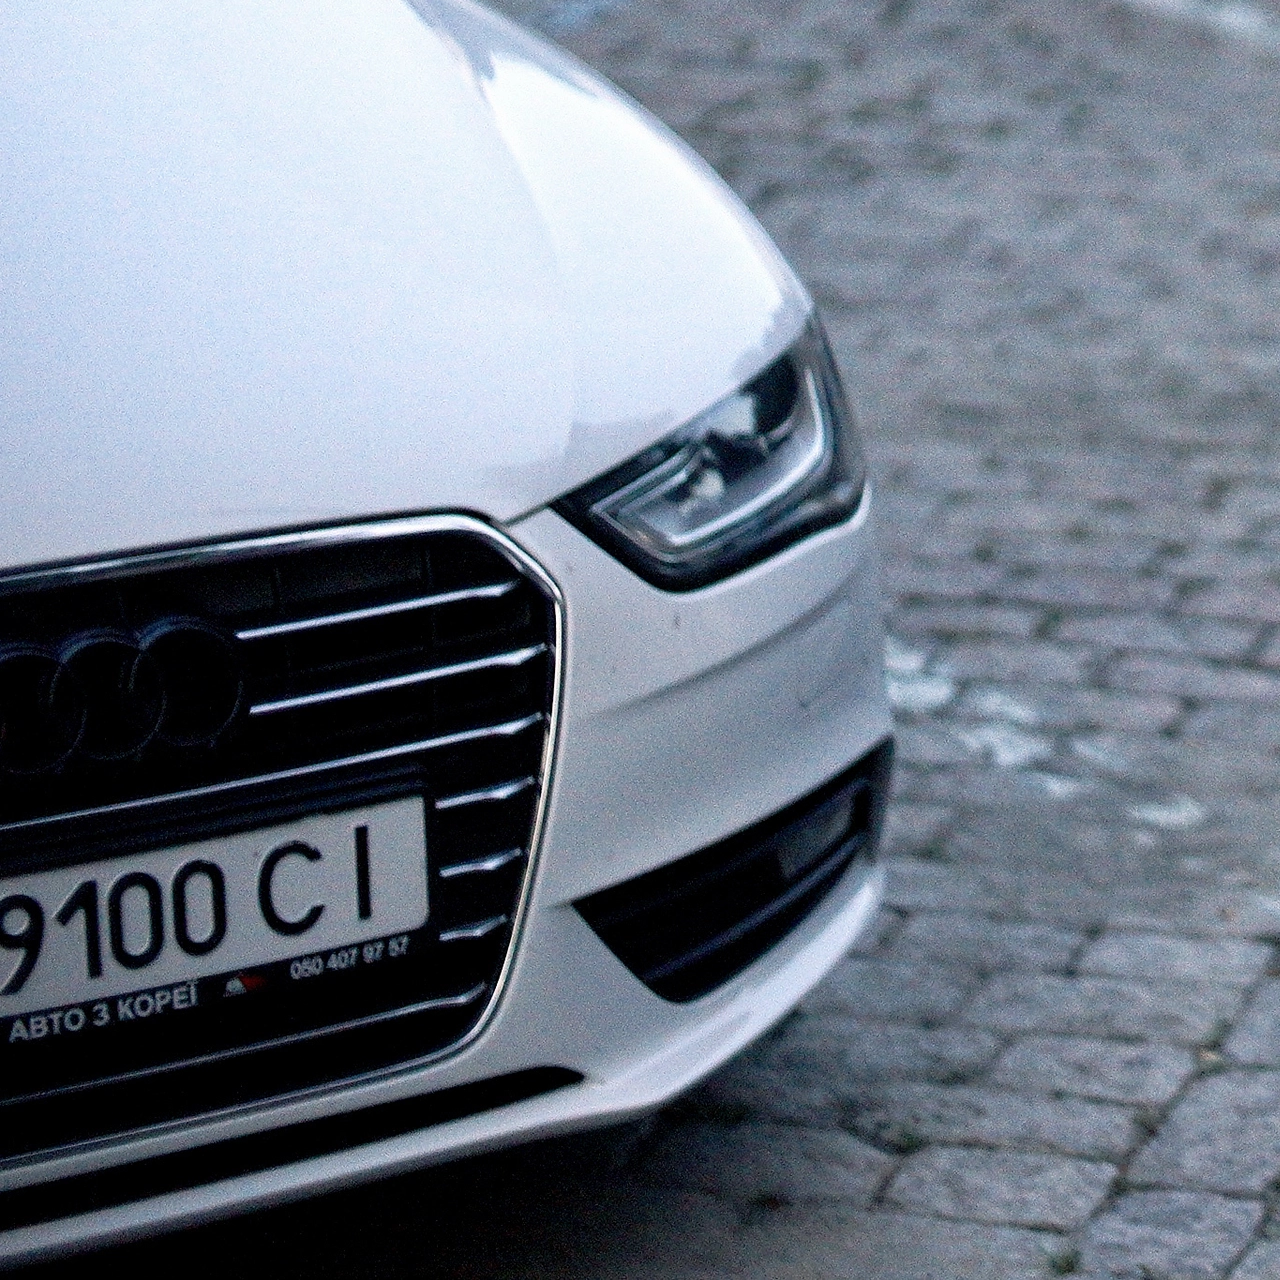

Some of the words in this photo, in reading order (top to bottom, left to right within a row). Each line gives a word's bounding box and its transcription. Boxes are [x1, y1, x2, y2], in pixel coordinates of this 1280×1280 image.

[0, 859, 227, 996] 9100
[9, 1007, 86, 1043] АВТО
[117, 980, 200, 1020] КОРЕЇ
